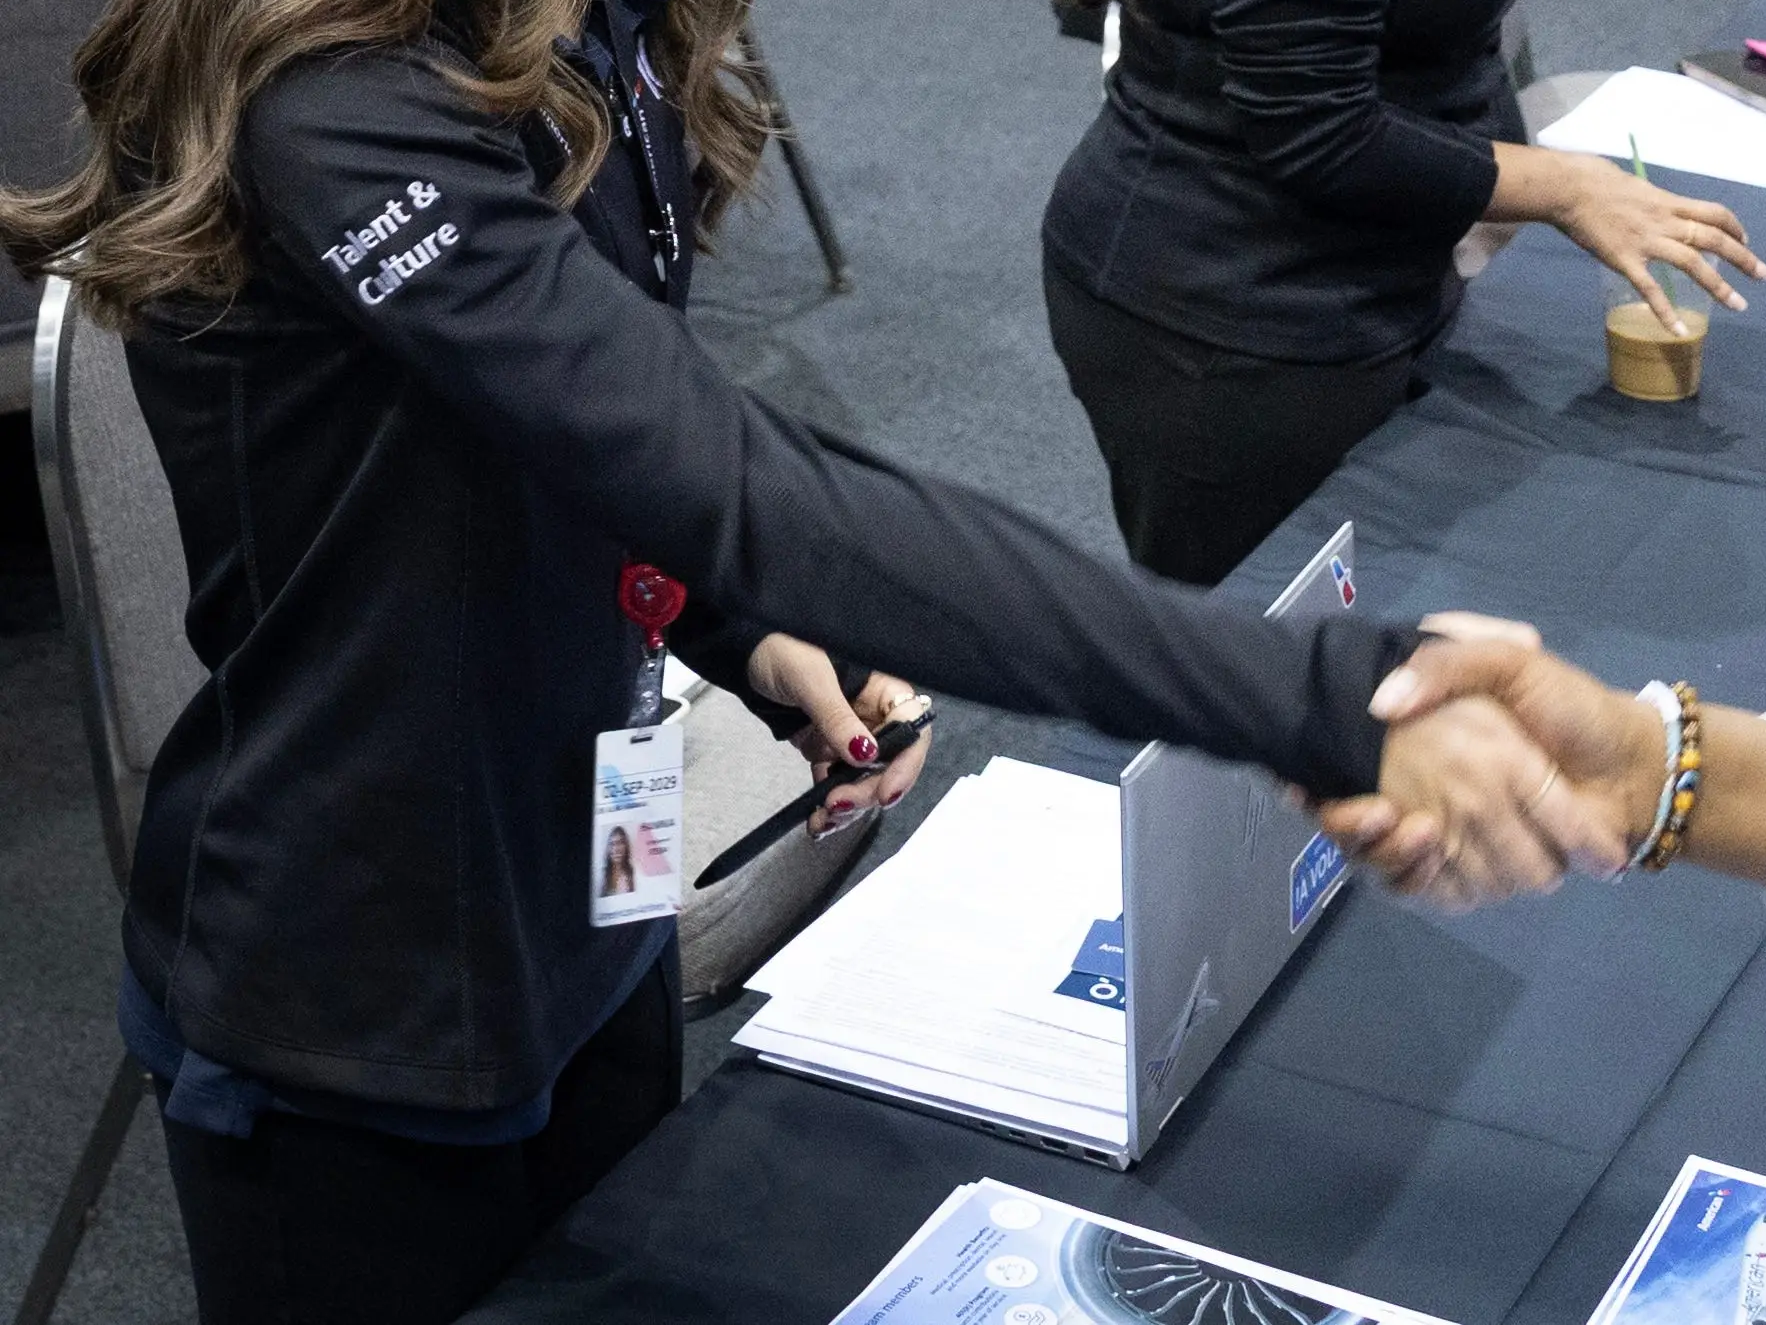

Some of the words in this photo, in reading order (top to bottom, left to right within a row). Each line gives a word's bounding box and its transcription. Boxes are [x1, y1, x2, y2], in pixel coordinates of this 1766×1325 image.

[321, 199, 413, 274] Talent
[406, 180, 442, 210] &
[358, 222, 461, 305] Culture
[882, 1275, 924, 1313] members
